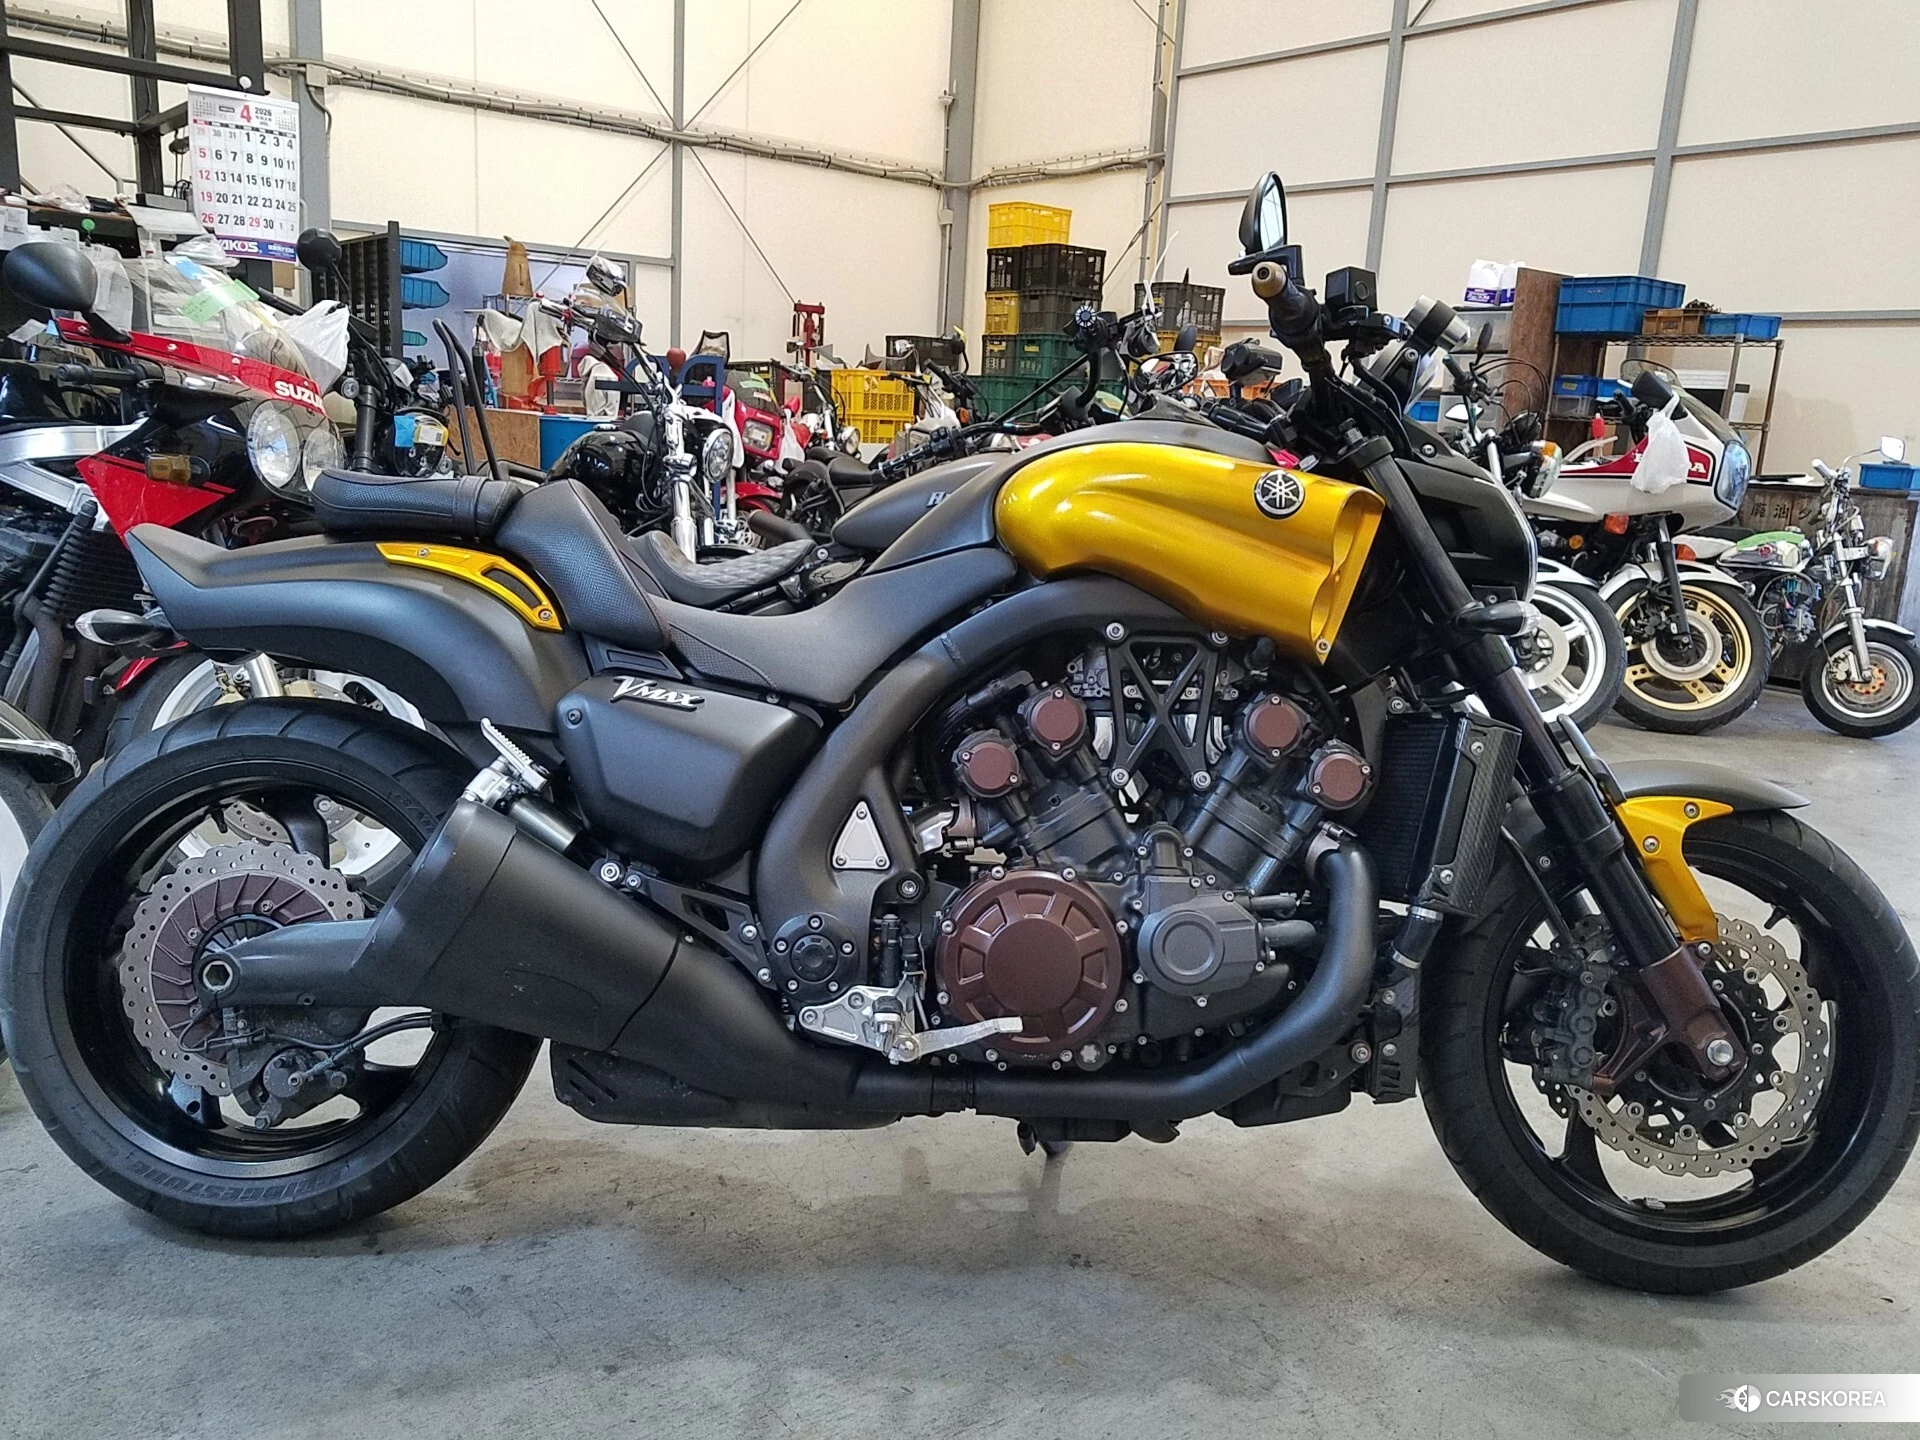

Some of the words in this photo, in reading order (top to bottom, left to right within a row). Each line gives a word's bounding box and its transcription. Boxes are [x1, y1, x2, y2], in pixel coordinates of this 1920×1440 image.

[241, 105, 252, 123] 4
[255, 107, 272, 116] 2026
[213, 129, 221, 137] 30
[229, 131, 236, 139] 31
[245, 132, 250, 142] 1
[259, 134, 266, 144] 2
[273, 137, 280, 147] 3
[287, 140, 293, 149] 4
[199, 148, 206, 158] 5
[215, 150, 222, 160] 6
[230, 151, 238, 161] 7
[246, 153, 254, 164] 8
[261, 155, 268, 166] 9
[273, 158, 283, 168] 10
[287, 160, 295, 171] 11
[199, 170, 211, 181] 12
[215, 171, 227, 182] 13
[230, 172, 242, 184] 14
[246, 174, 257, 185] 15
[261, 176, 272, 187] 16
[275, 179, 284, 189] 17
[287, 181, 296, 192] 18
[201, 191, 212, 202] 19
[216, 192, 228, 203] 20
[231, 194, 243, 205] 21
[247, 196, 259, 207] 22
[262, 197, 273, 208] 23
[275, 200, 285, 211] 24
[288, 201, 296, 212] 25
[201, 212, 214, 224] 26
[217, 213, 230, 225] 27
[233, 215, 245, 226] 28
[248, 216, 260, 228] 29
[263, 218, 274, 229] 30
[274, 380, 323, 408] SUZU
